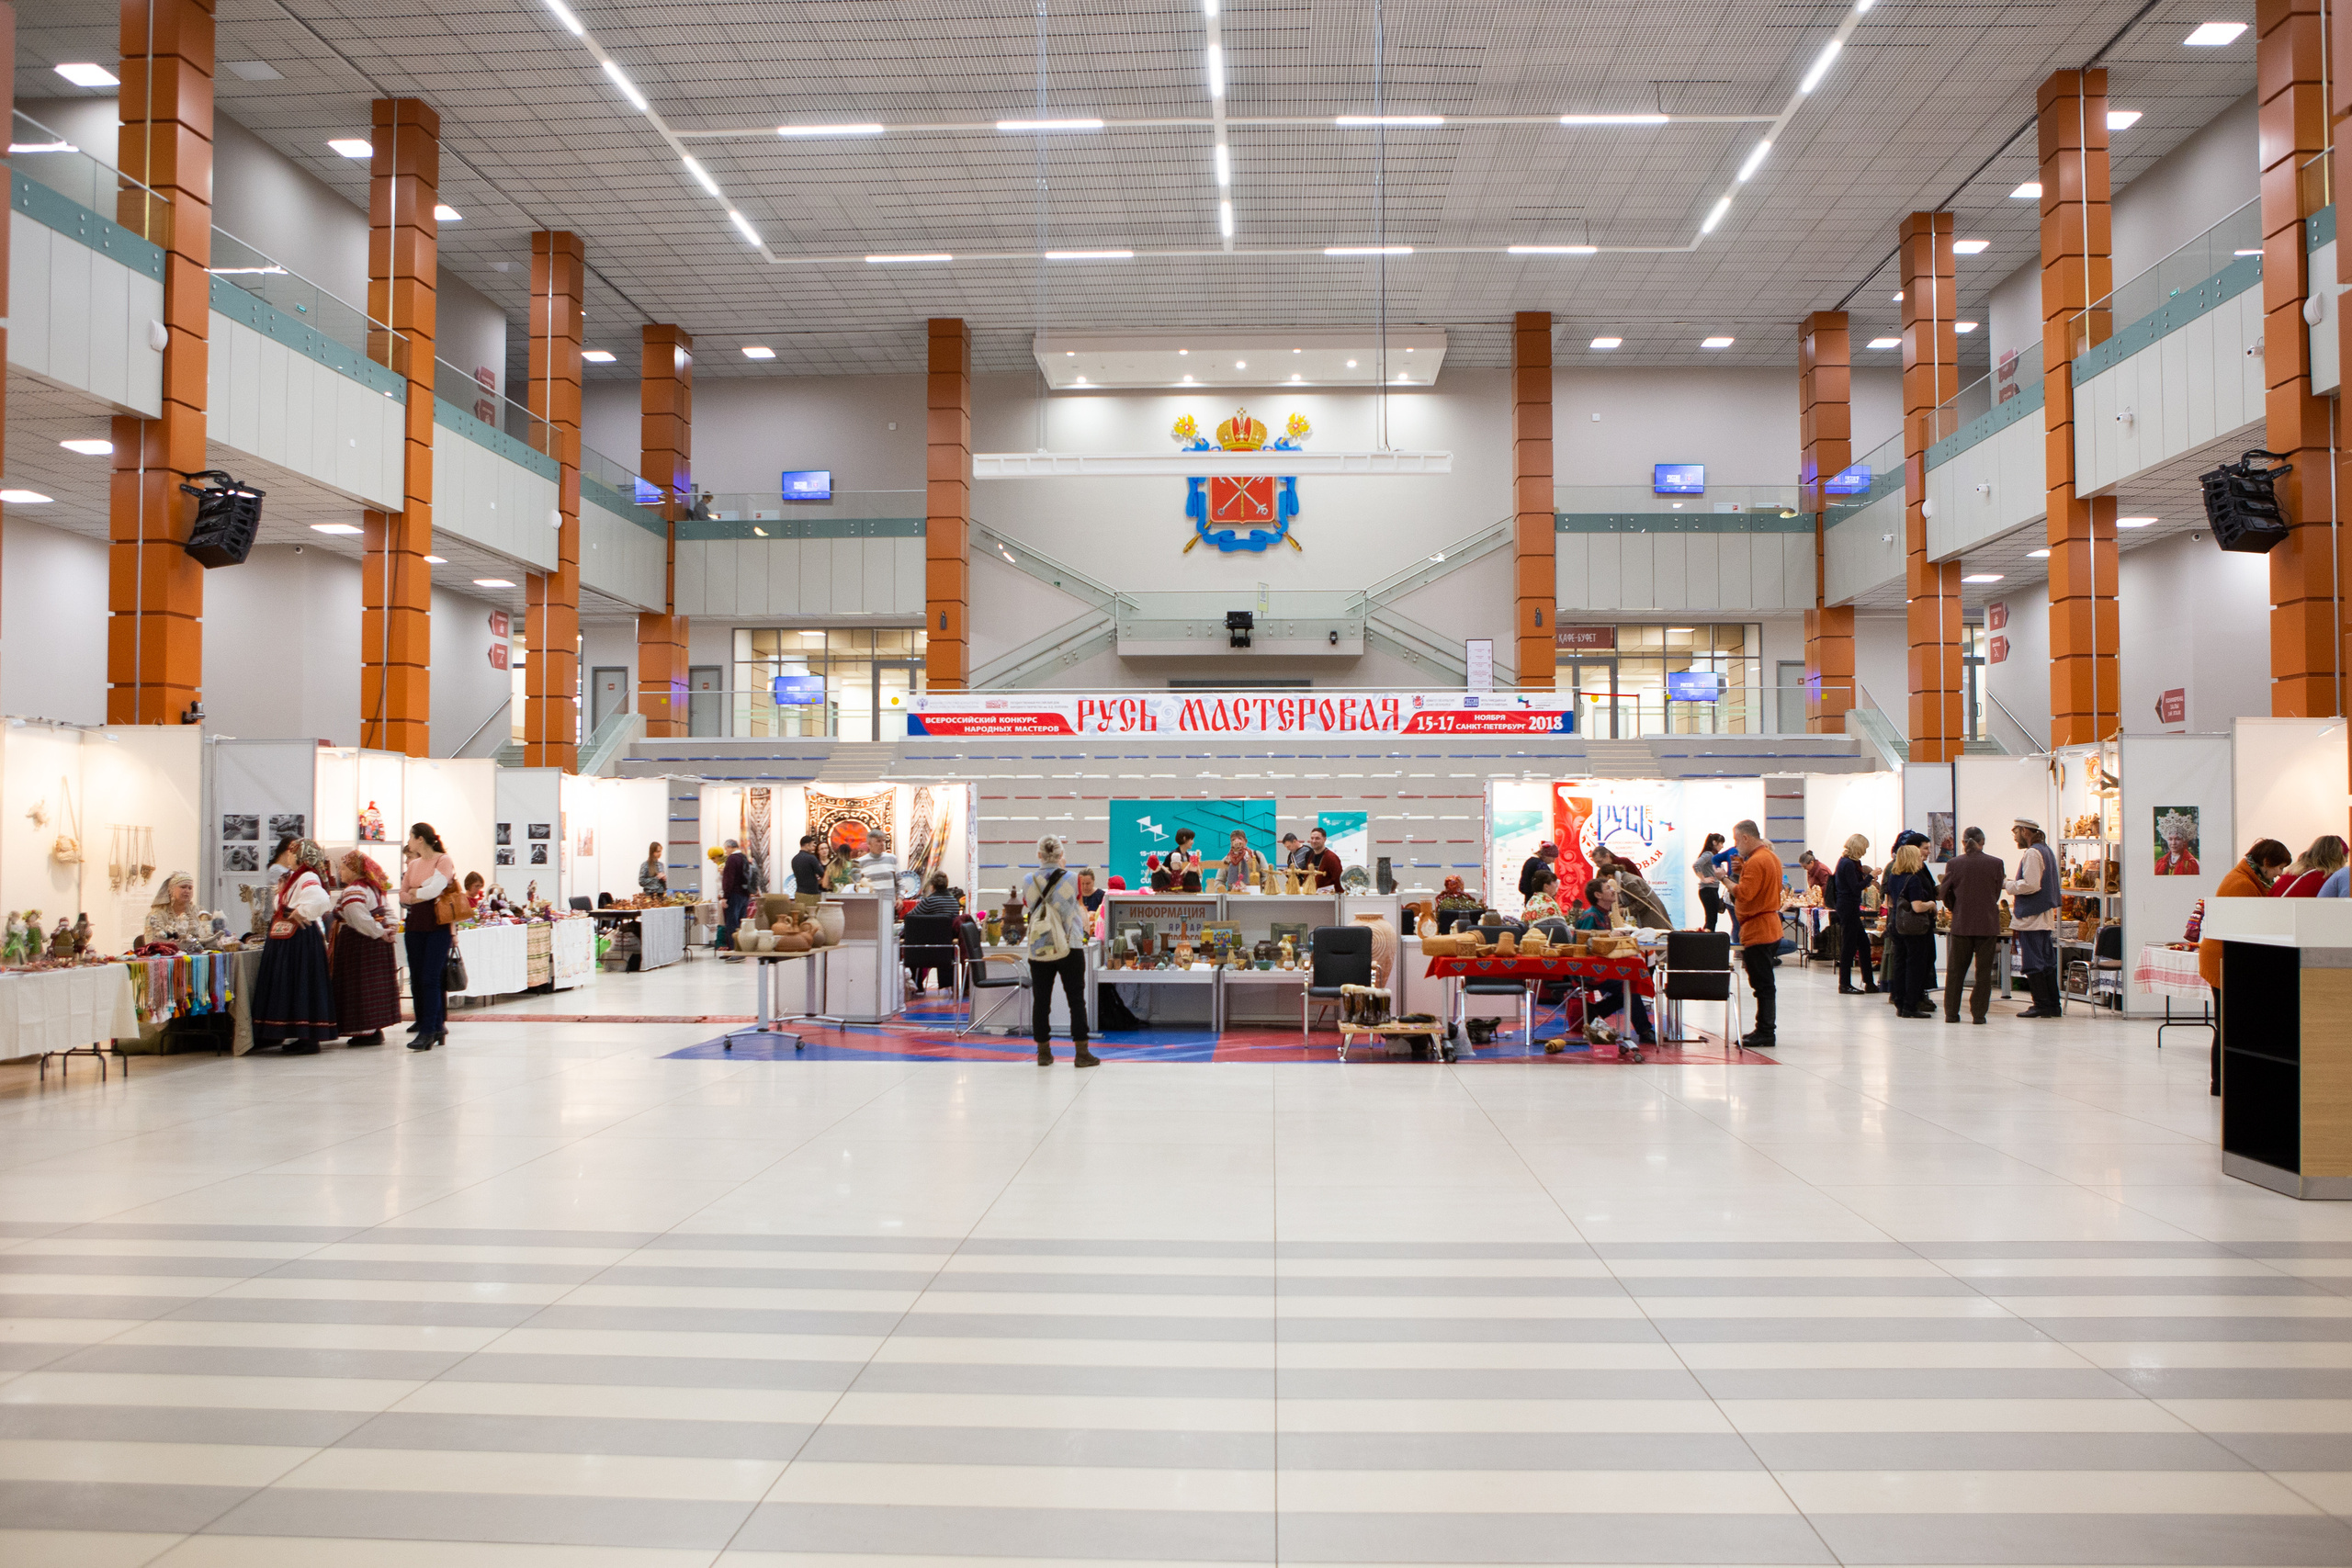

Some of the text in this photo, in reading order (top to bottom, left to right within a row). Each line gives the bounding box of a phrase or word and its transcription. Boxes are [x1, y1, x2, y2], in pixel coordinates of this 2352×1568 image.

[1558, 633, 1597, 644] КАФЕ-БУФЕТ
[1078, 698, 1398, 732] РУСЬ МАСТЕРОВАЯ
[1417, 716, 1454, 731] 15-17
[1528, 716, 1564, 730] 2018
[1129, 906, 1206, 919] ИНФОРМАЦИЯ
